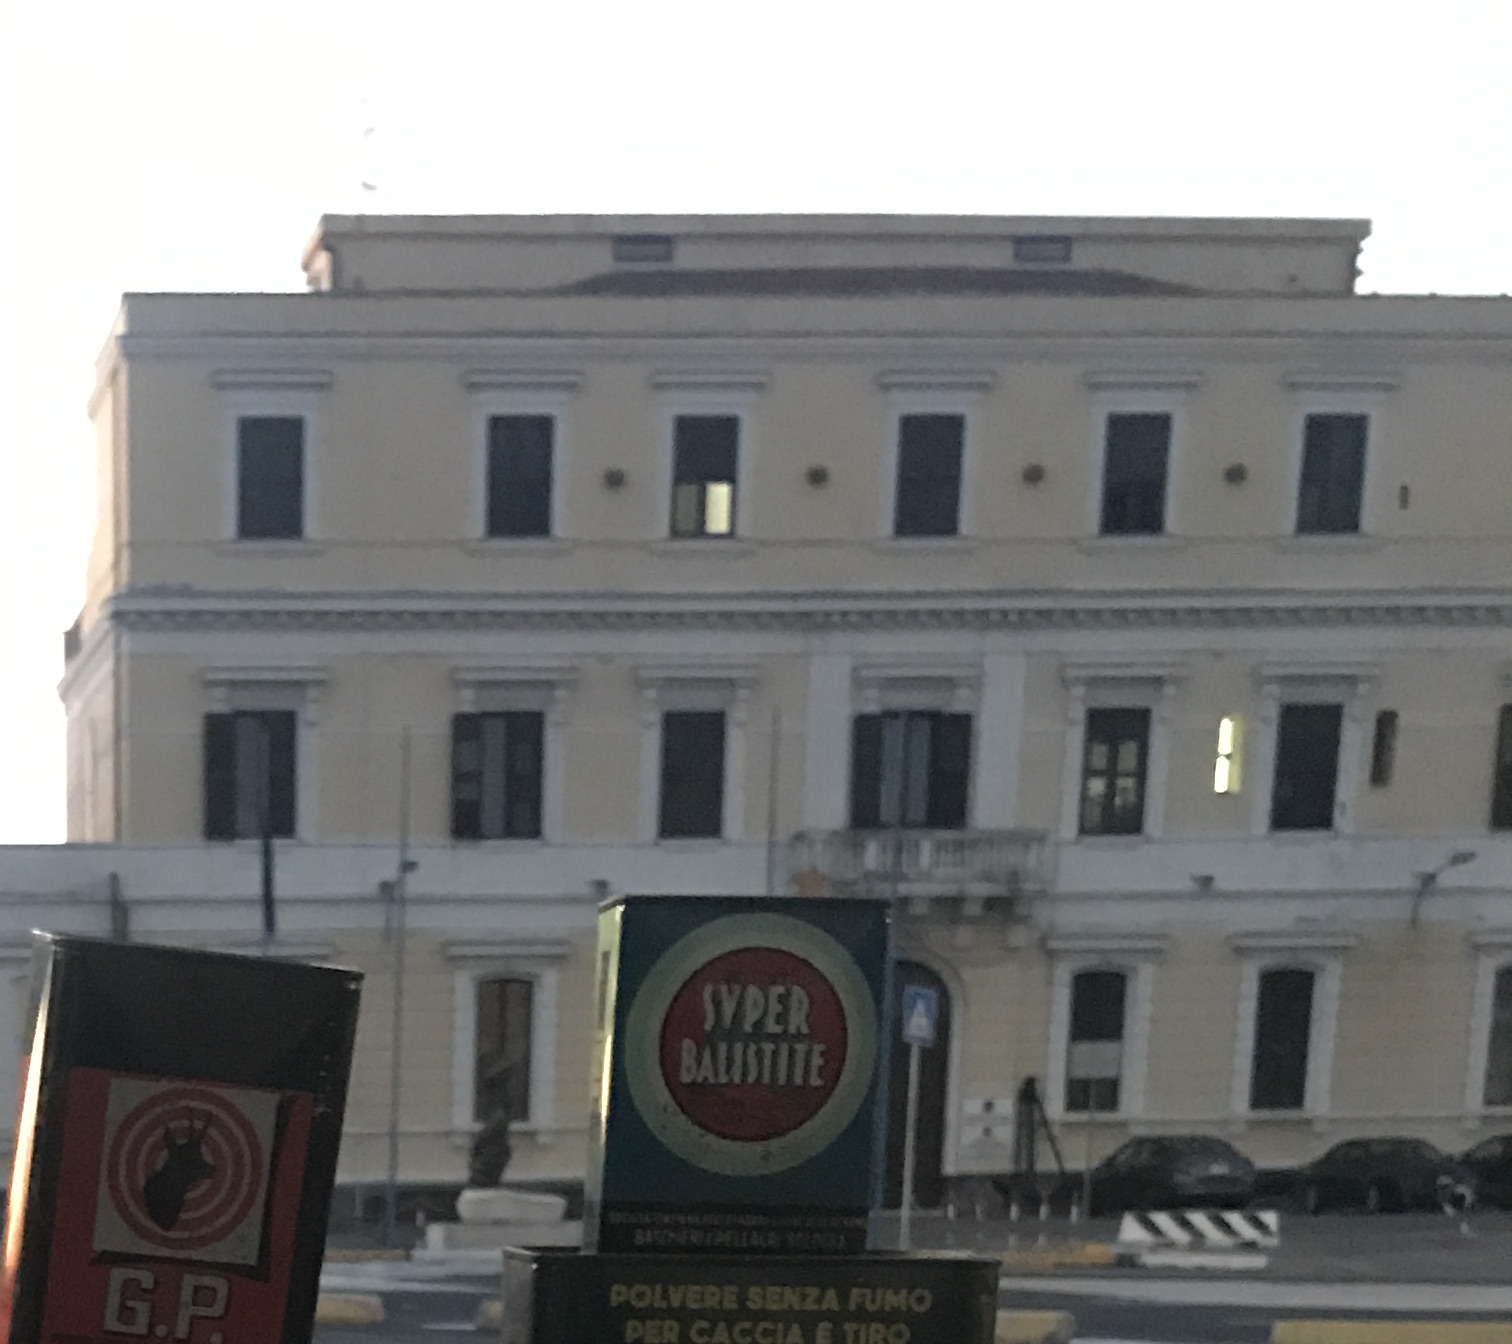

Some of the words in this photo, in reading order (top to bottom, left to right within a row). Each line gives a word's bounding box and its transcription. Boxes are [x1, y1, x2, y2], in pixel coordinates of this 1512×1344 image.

[610, 1284, 738, 1310] POLVERE
[746, 1285, 840, 1313] SENZA
[848, 1287, 933, 1314] FUMO
[625, 1321, 680, 1344] PER
